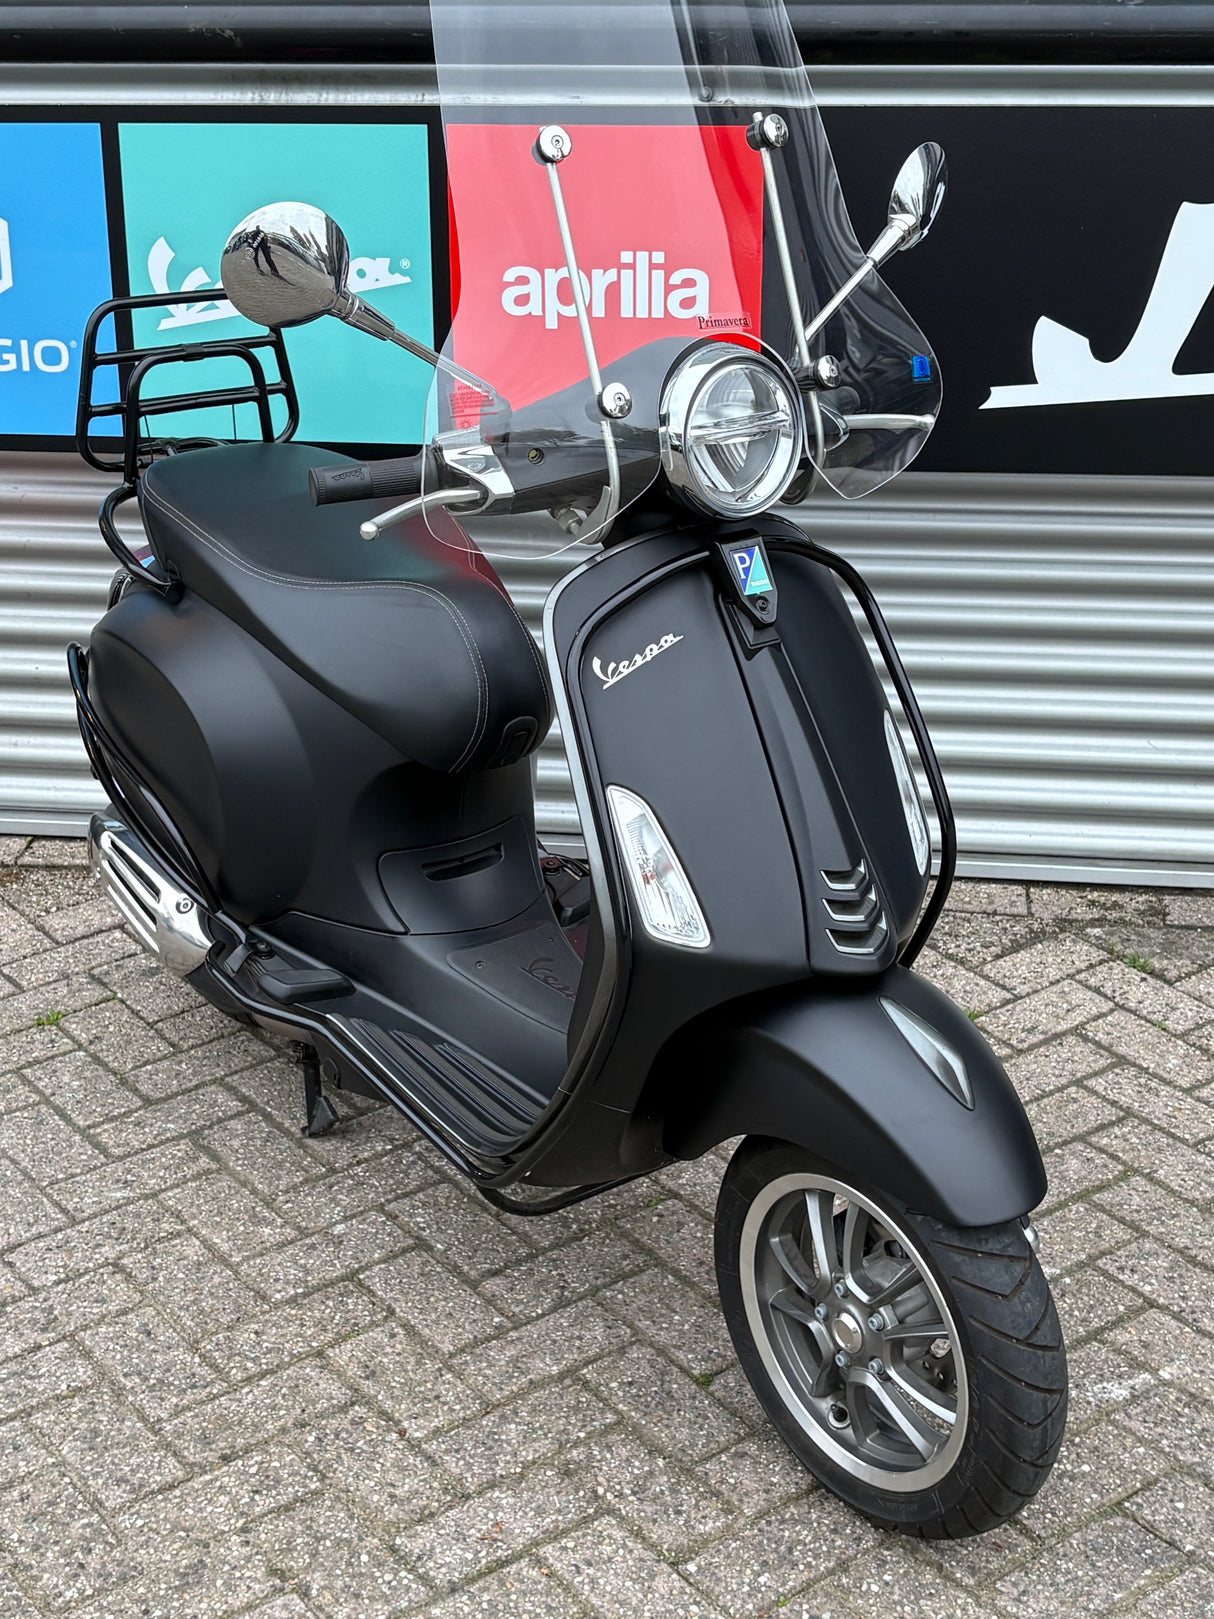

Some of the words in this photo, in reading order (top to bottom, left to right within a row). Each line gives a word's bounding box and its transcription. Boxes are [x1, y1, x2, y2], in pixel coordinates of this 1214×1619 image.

[501, 251, 709, 329] aprilia
[698, 316, 749, 329] Primavera
[592, 633, 684, 690] Vespa
